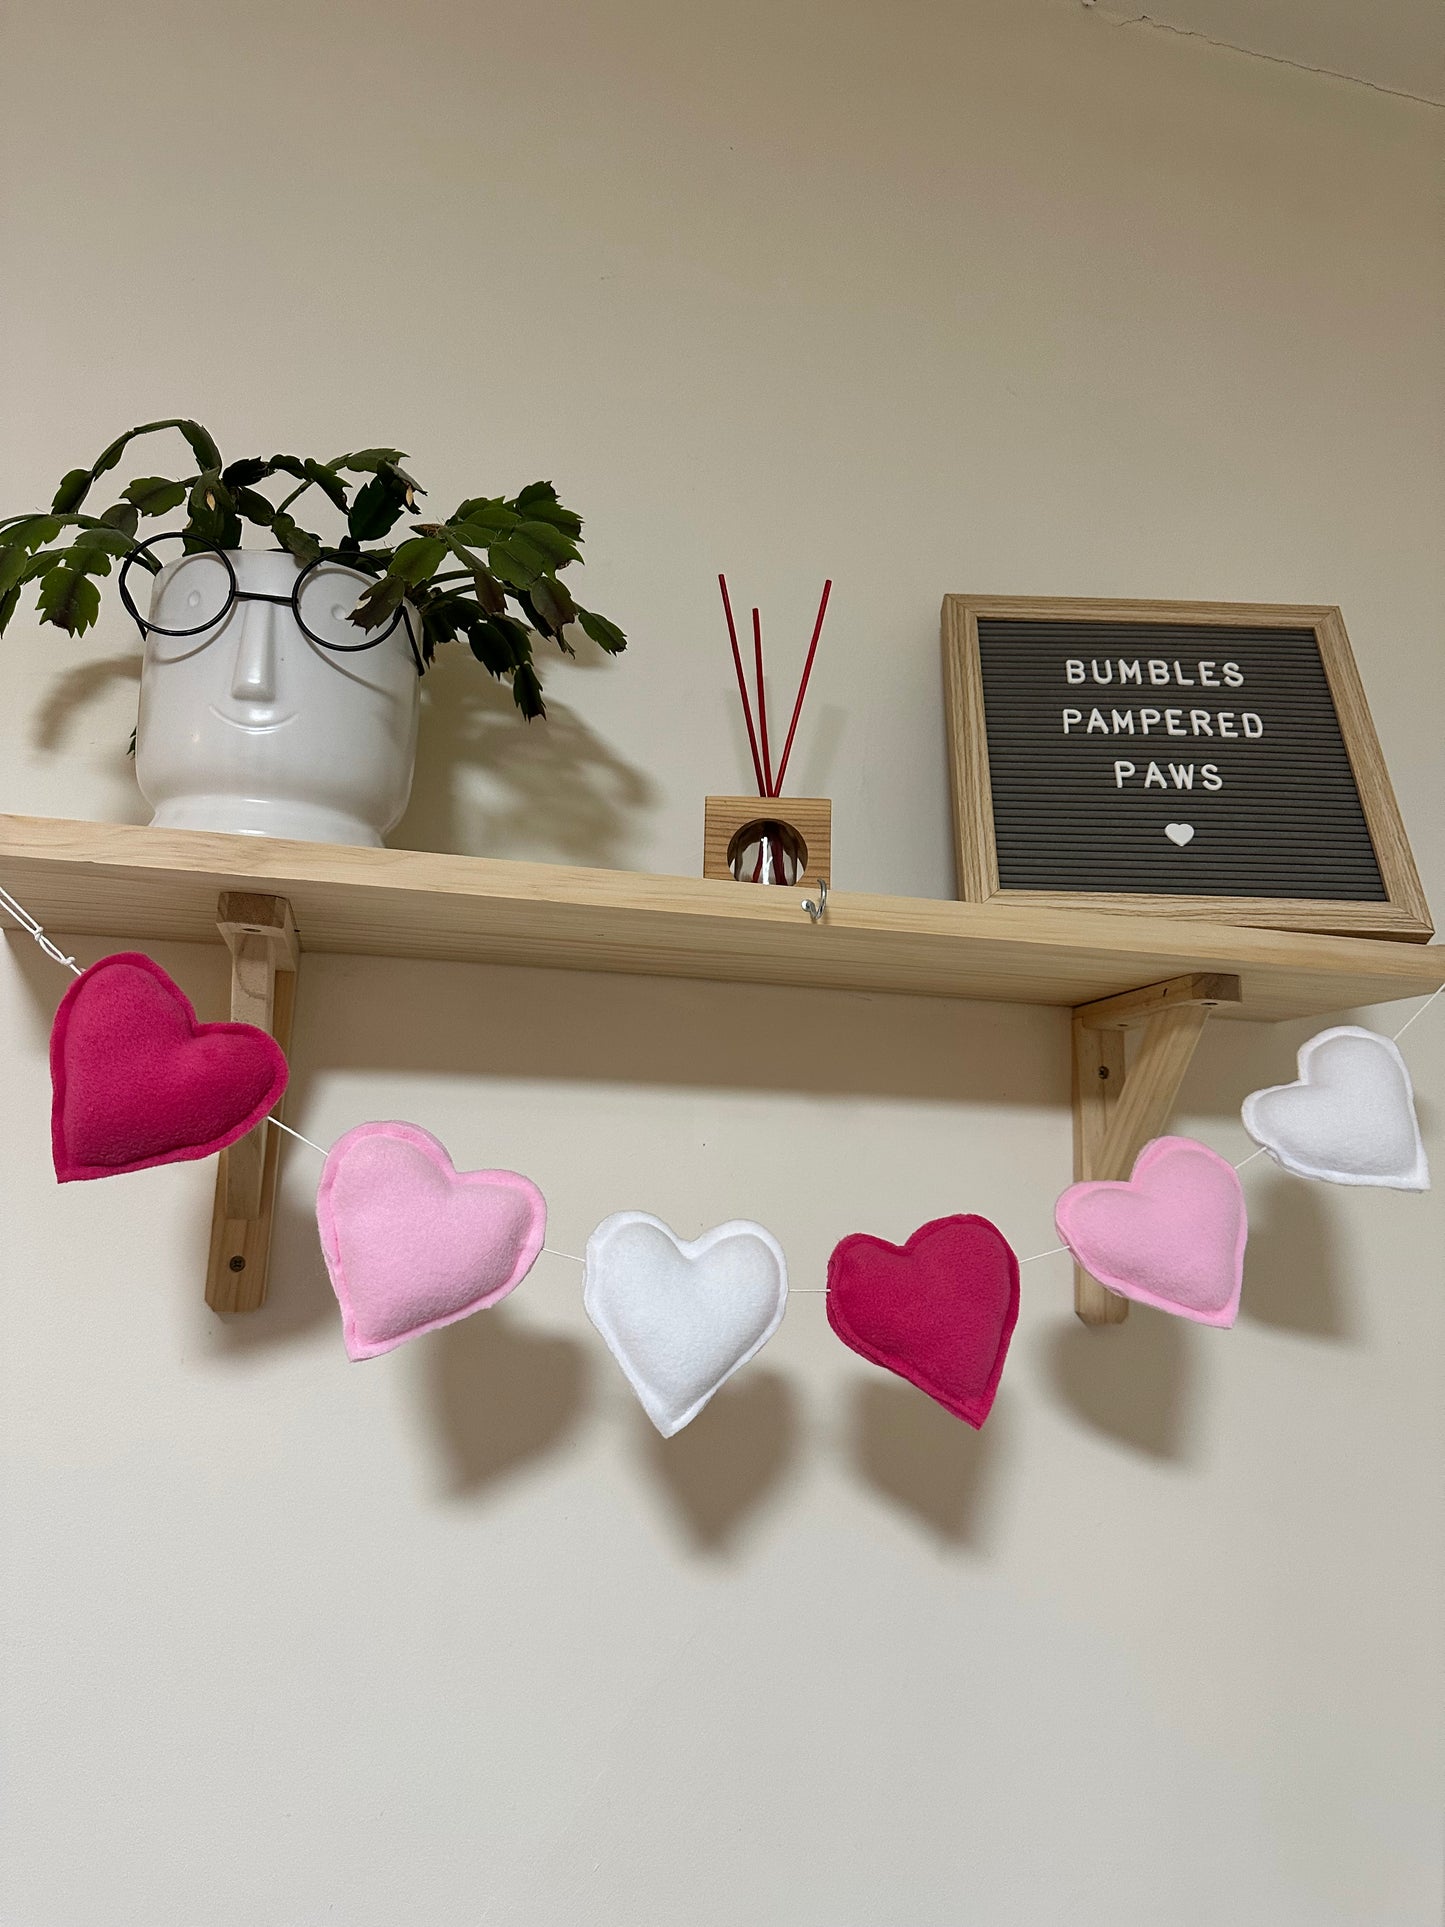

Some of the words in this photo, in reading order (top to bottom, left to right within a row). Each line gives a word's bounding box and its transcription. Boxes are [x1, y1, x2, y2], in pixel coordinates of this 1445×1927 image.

[1065, 659, 1244, 687] BUMBLES
[1062, 707, 1263, 738] PAMPERED
[1114, 760, 1223, 791] PAWS
